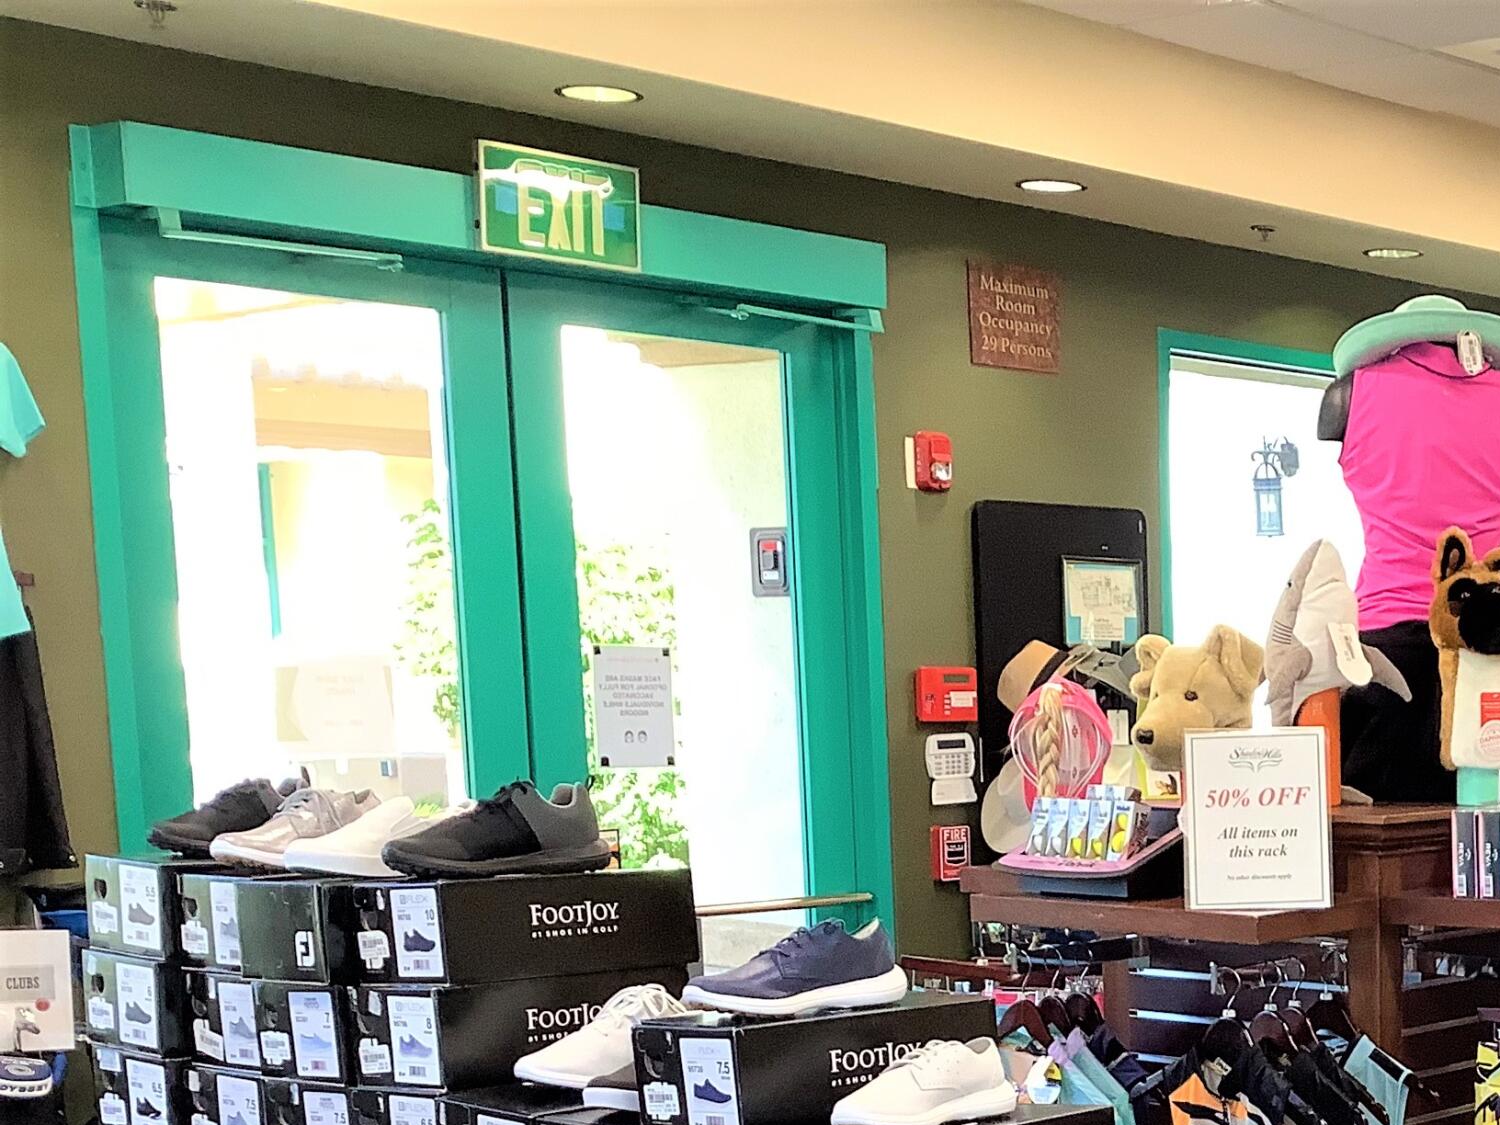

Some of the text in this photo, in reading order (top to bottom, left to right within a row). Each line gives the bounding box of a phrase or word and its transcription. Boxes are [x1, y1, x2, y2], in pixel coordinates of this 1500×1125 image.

[516, 160, 605, 256] EXIT
[980, 275, 1049, 299] Maximum
[996, 294, 1035, 315] Room
[979, 311, 1052, 336] Occupancy
[981, 334, 1052, 359] 29 Persons
[1205, 786, 1311, 809] 50% OFF
[943, 828, 967, 841] FIRE
[1217, 827, 1298, 840] All items on
[1229, 844, 1288, 858] this rack
[425, 909, 435, 922] 10
[545, 928, 573, 938] SHOE
[577, 926, 588, 936] IN
[592, 925, 619, 934] GOLF
[6, 976, 40, 990] CLUBS
[324, 1011, 330, 1024] 7
[426, 1018, 432, 1030] 8
[525, 1003, 603, 1031] FOOTJO
[716, 1061, 730, 1075] 7.5
[333, 1112, 347, 1125] 7.5
